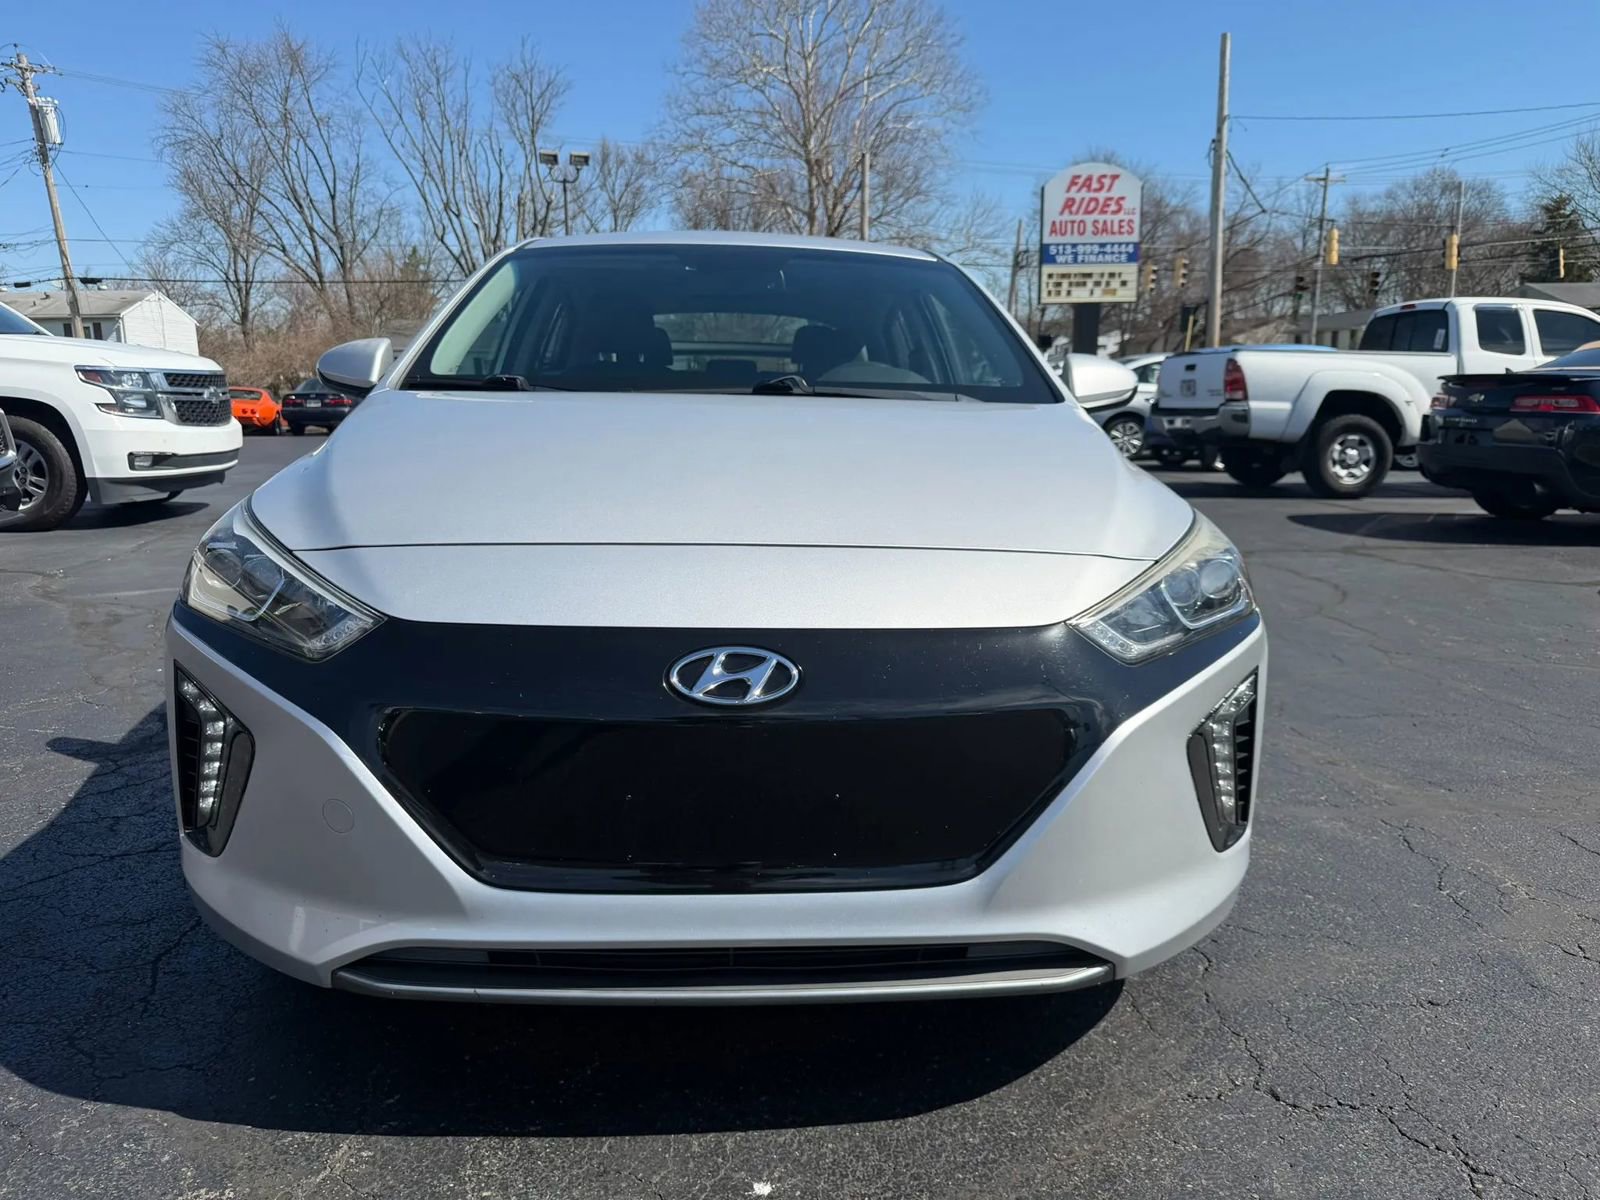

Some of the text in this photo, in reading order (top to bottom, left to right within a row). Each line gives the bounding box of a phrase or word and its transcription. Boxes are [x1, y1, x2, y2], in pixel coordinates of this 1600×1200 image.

[1066, 174, 1121, 193] FAST
[1060, 197, 1125, 215] RIDES
[1049, 220, 1134, 236] AUTO SALES
[1049, 244, 1134, 255] 513-999-4444
[1056, 254, 1128, 264] WE FINANCE
